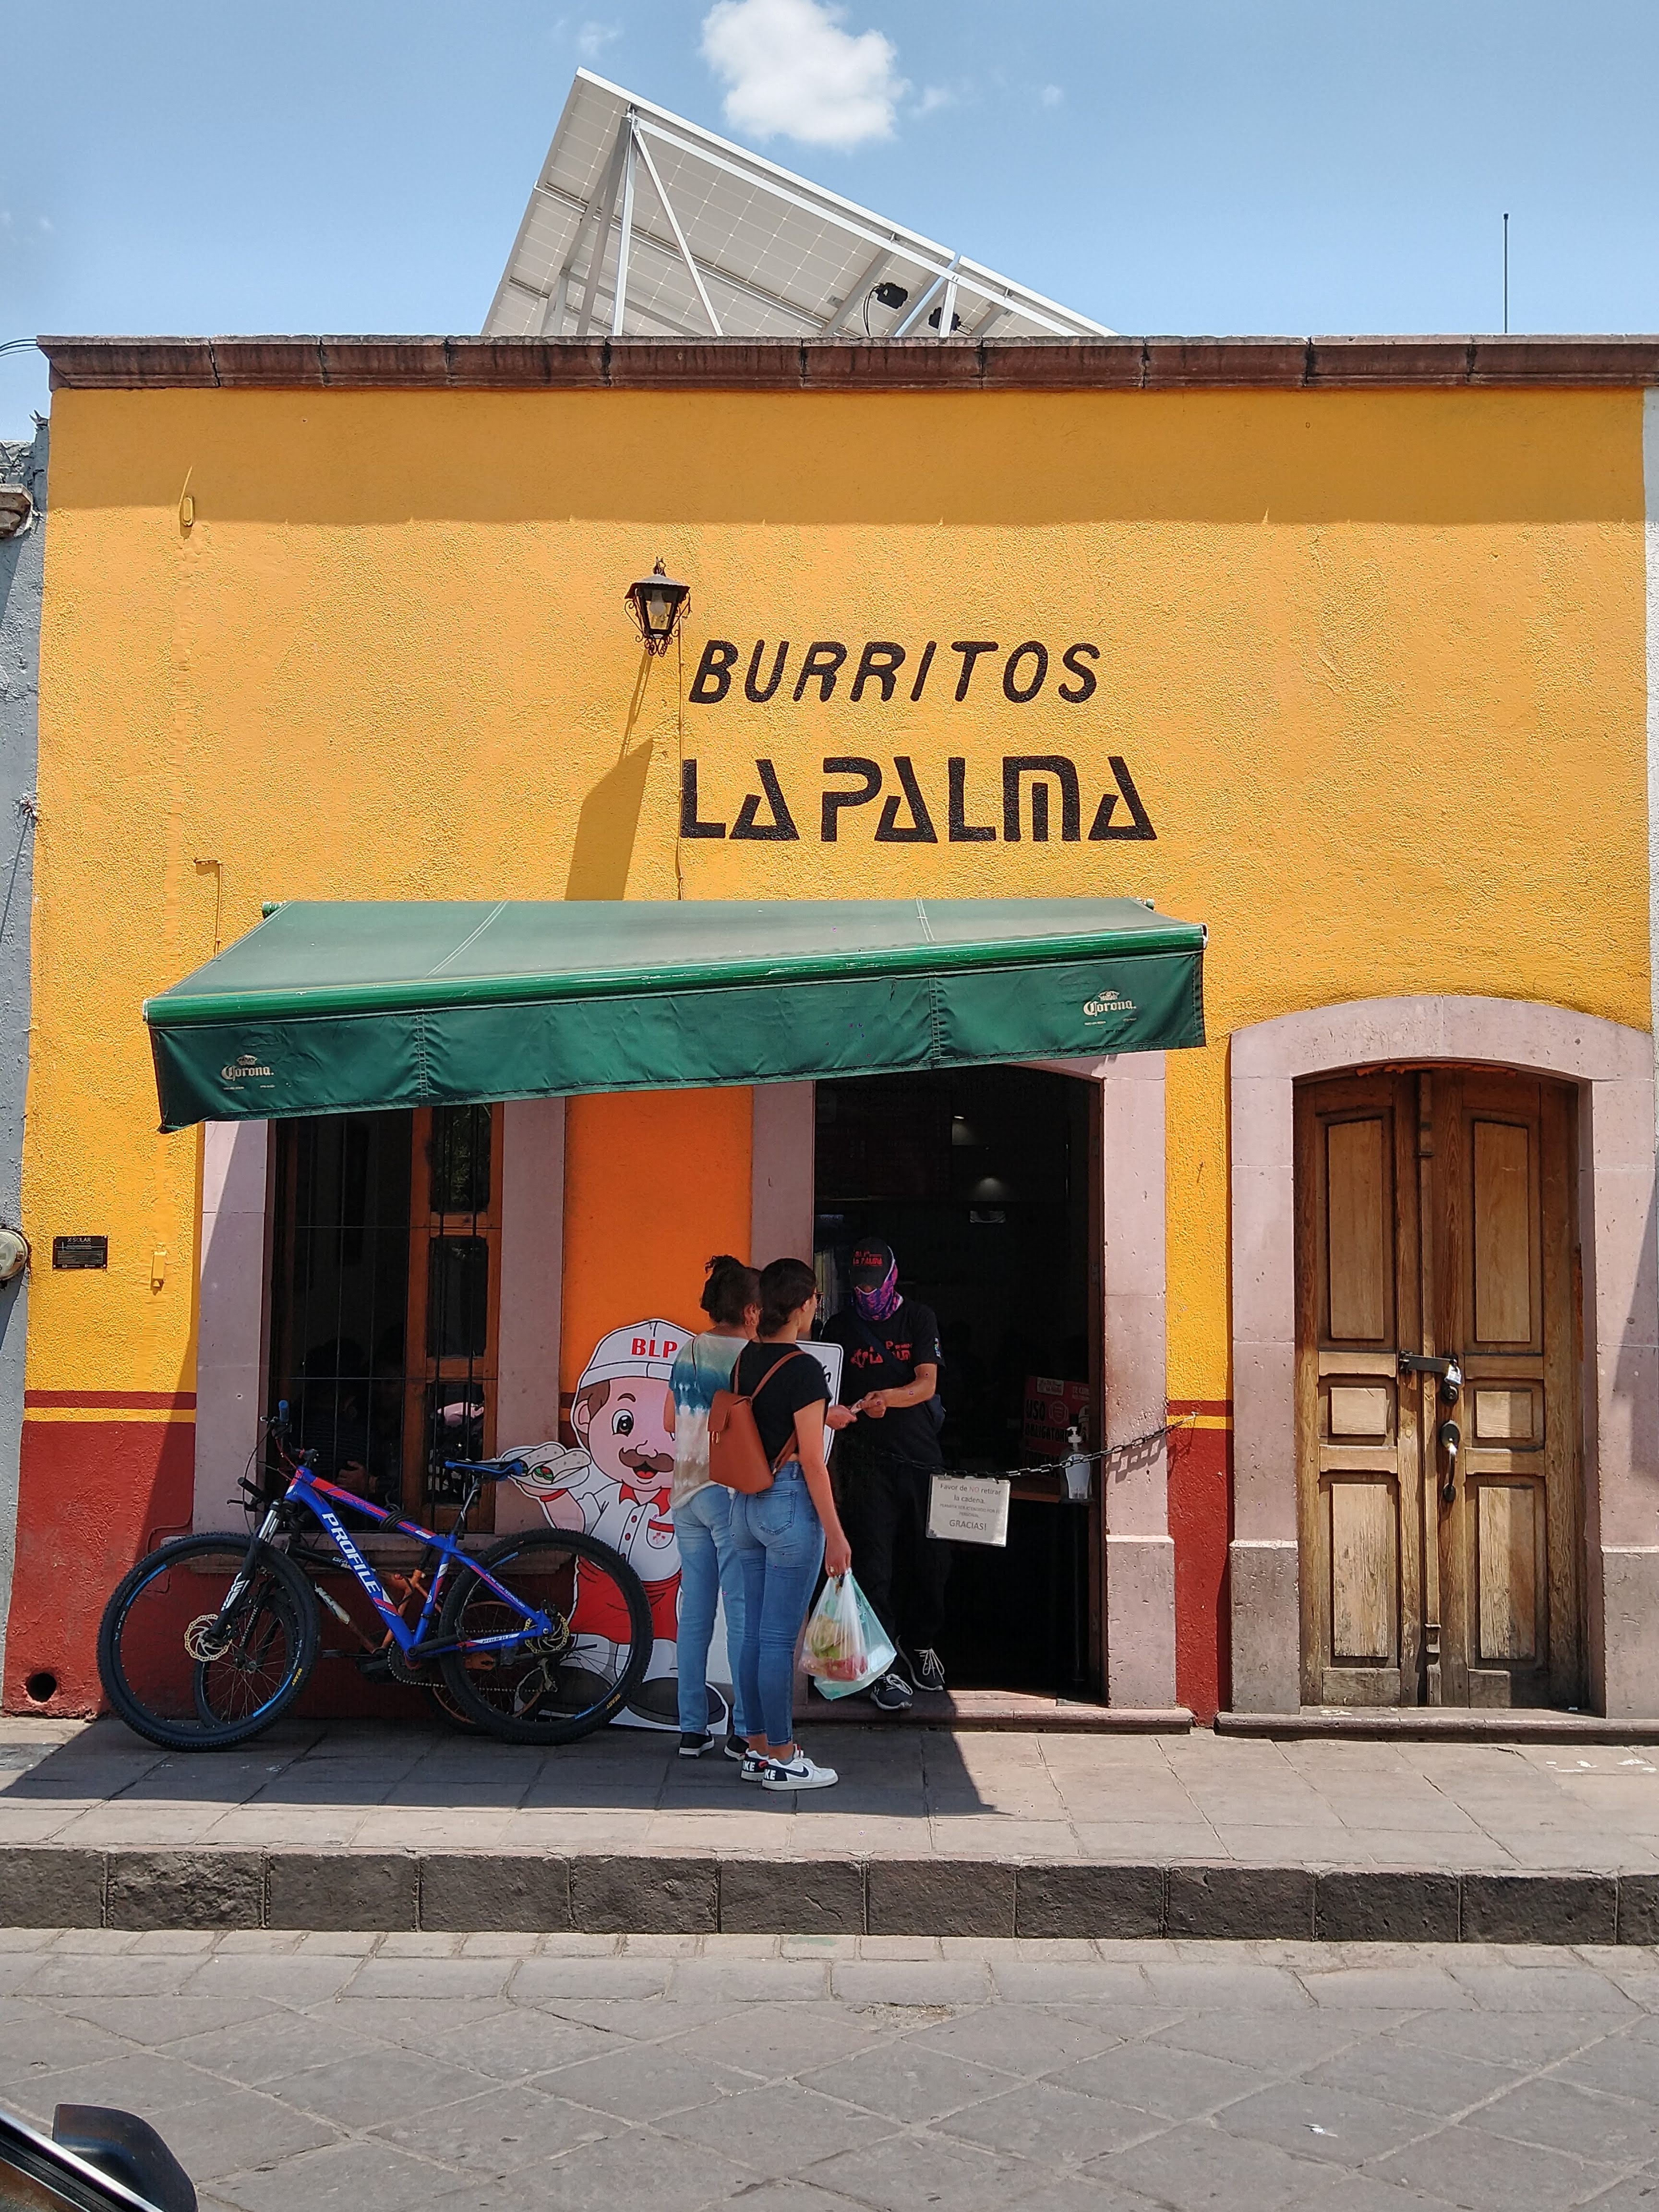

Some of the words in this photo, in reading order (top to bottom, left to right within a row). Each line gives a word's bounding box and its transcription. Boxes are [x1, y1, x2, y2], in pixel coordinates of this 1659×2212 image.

[688, 639, 1101, 704] BURRITOS
[681, 758, 800, 841] LA
[820, 755, 1158, 843] PALMA
[1083, 1000, 1136, 1017] Corona
[221, 1065, 274, 1081] Corona
[631, 1338, 678, 1358] BLP
[949, 1519, 986, 1531] GRACIAS!
[321, 1513, 381, 1593] PROFILE
[291, 1668, 302, 1686] BEAST
[743, 1760, 756, 1771] IKE
[764, 1768, 776, 1780] KE
